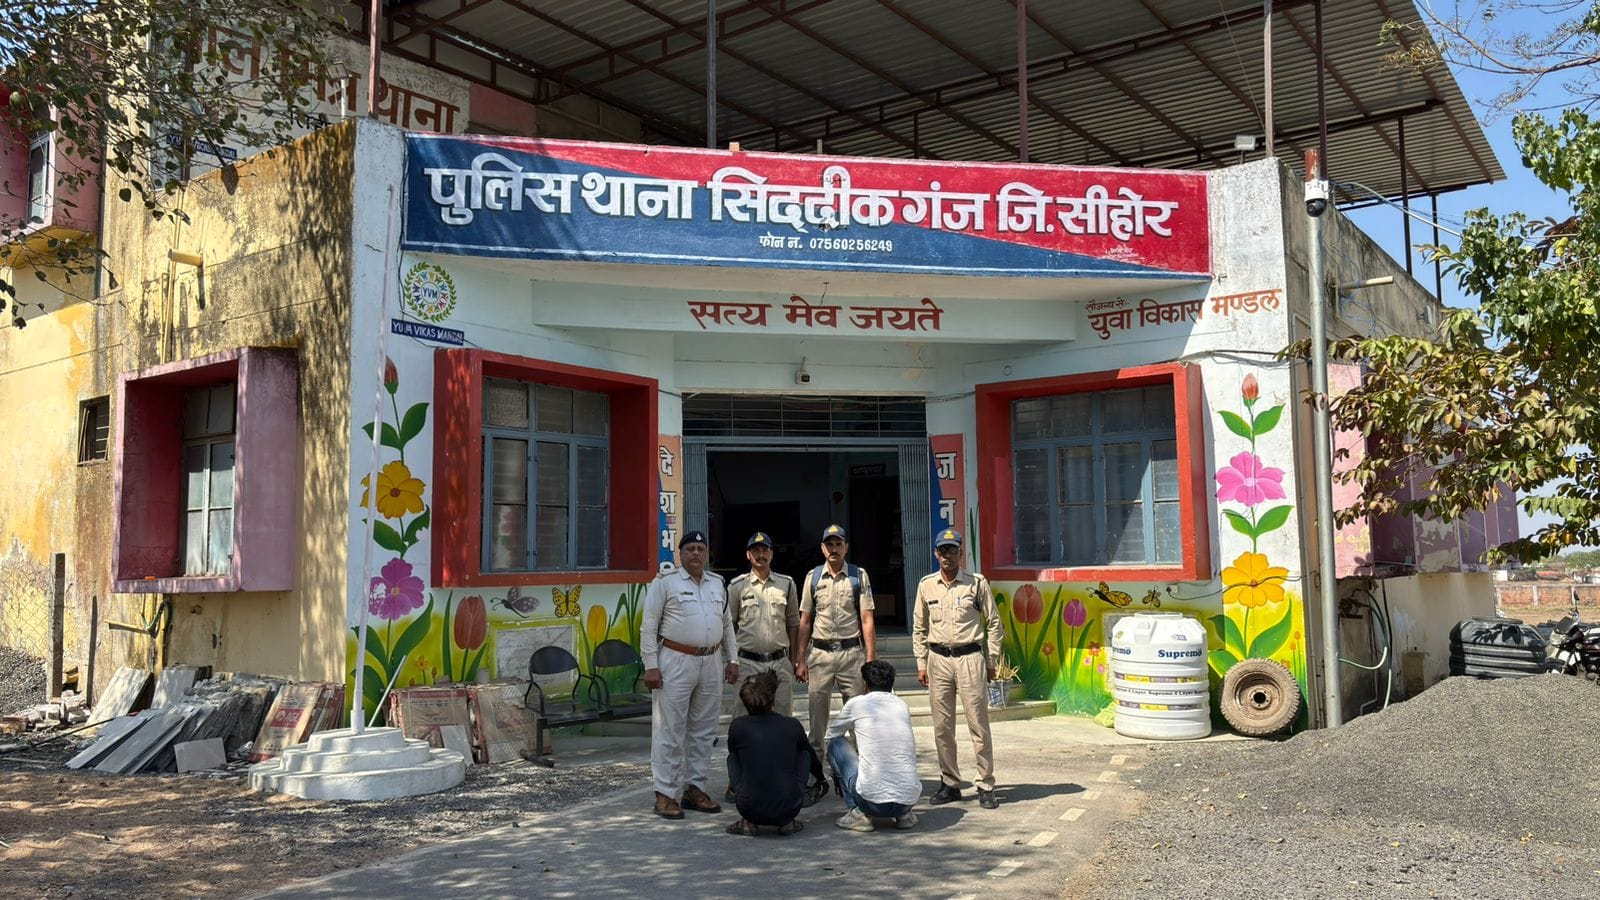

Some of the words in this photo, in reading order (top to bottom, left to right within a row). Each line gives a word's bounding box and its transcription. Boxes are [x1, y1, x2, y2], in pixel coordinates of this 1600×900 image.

[424, 152, 577, 226] पुलिस
[582, 171, 699, 219] थाना
[759, 231, 785, 248] फोन
[809, 238, 893, 252] 07560256249
[423, 287, 438, 299] YVM
[687, 301, 772, 330] सत्य
[783, 295, 842, 328] मेव
[849, 297, 944, 331] जयते
[1088, 309, 1133, 340] युवा
[1137, 298, 1205, 327] विकास
[1211, 288, 1282, 318] मण्डल
[413, 324, 437, 338] VIKAS
